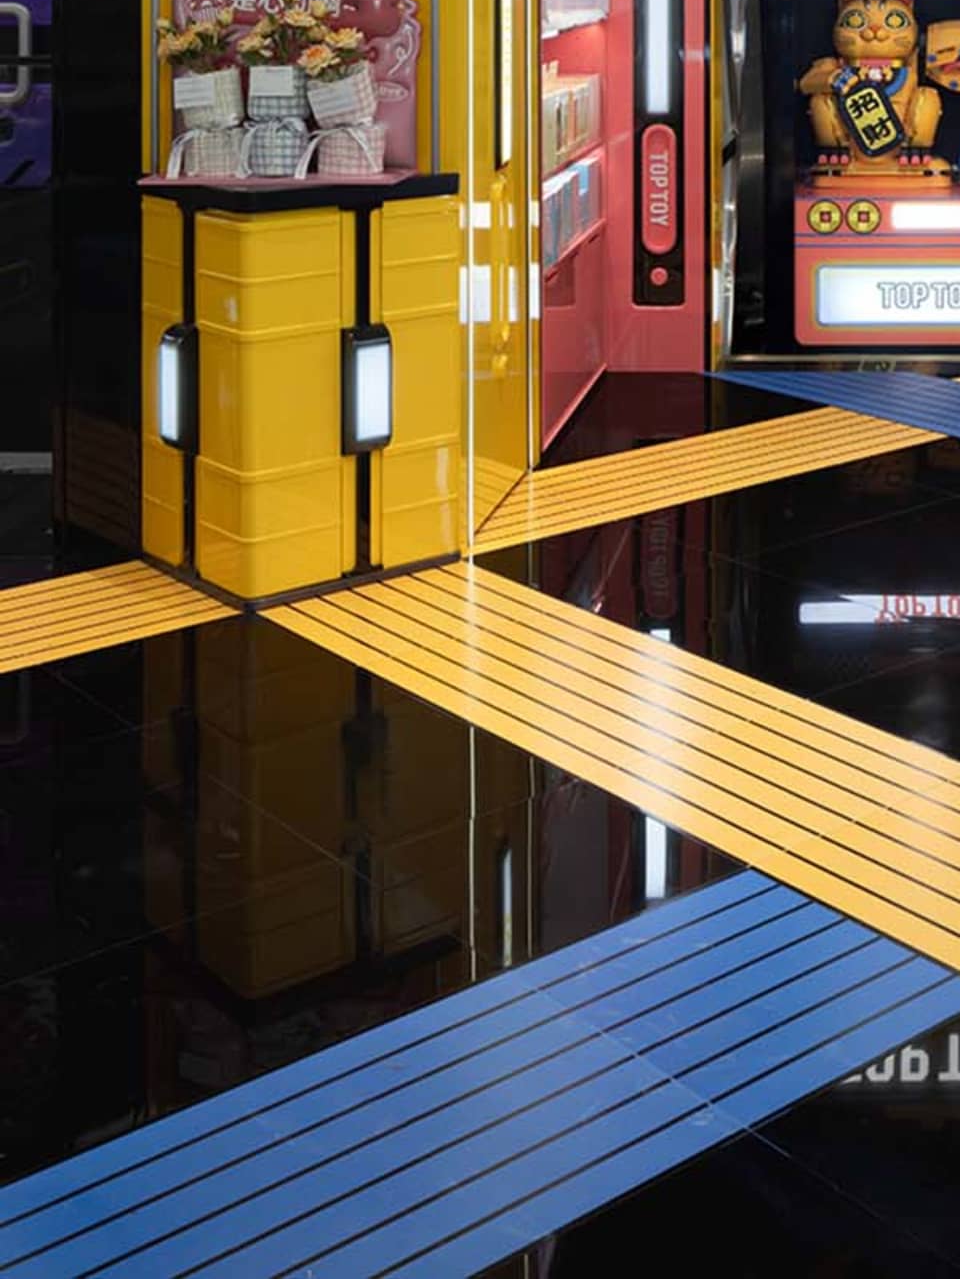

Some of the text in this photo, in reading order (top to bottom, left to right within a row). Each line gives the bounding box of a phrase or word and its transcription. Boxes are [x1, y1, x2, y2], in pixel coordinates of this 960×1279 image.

[650, 150, 668, 227] TOP TOY
[877, 281, 929, 309] TOP
